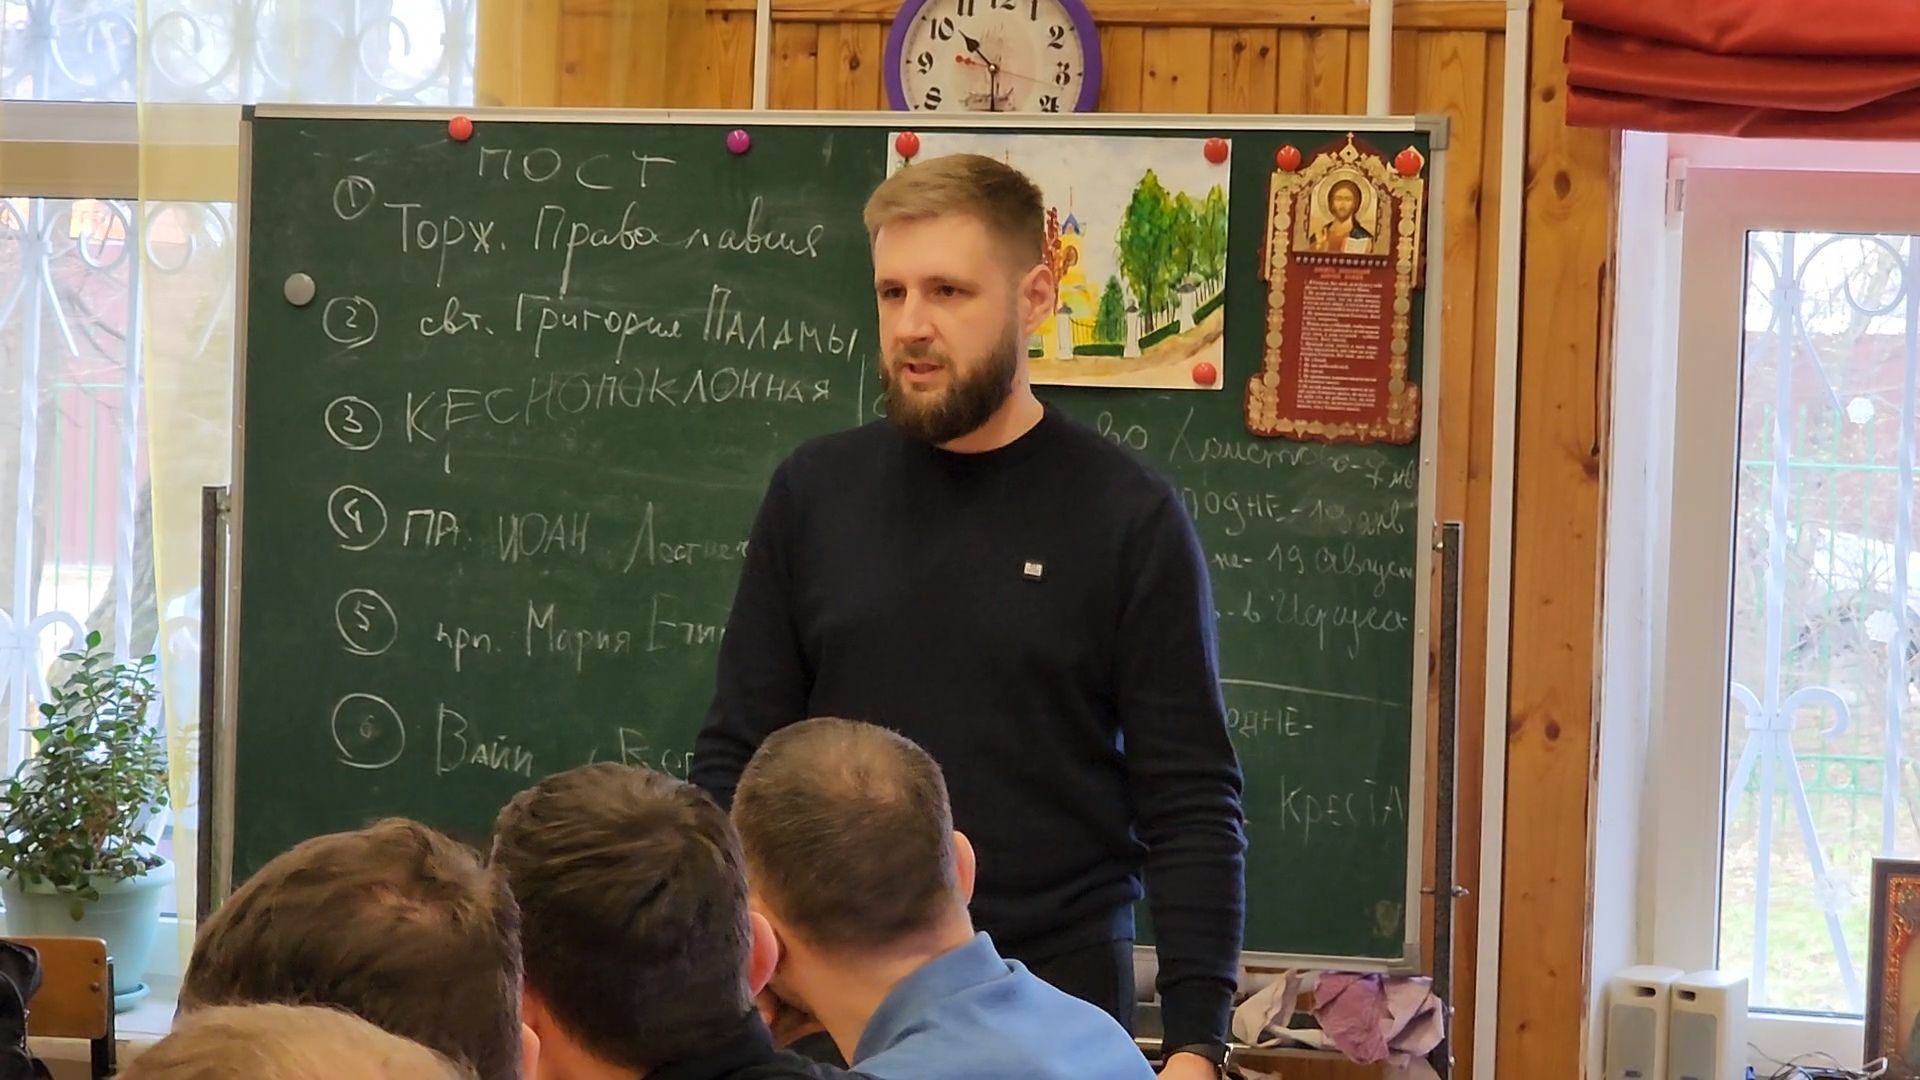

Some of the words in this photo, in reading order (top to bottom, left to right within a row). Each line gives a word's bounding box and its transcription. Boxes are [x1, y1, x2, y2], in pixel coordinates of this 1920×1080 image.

[930, 17, 954, 41] 10
[1048, 25, 1065, 50] 2
[917, 51, 934, 75] 9
[478, 147, 677, 190] ПОСТ
[1267, 543, 1305, 575] 19
